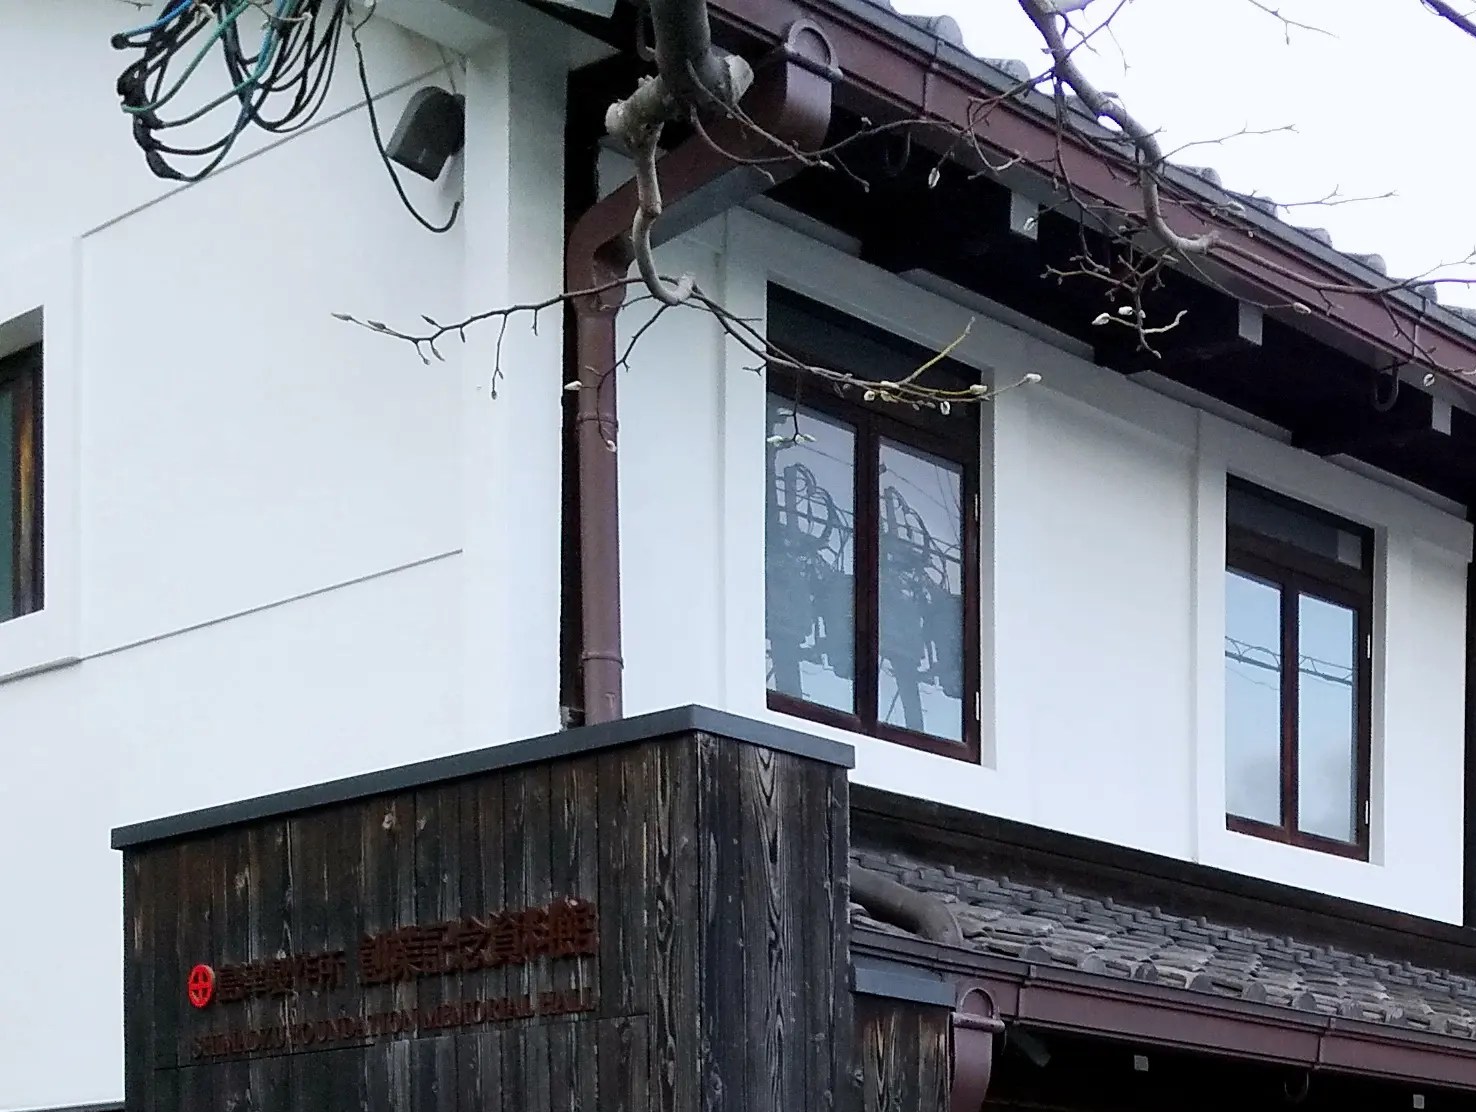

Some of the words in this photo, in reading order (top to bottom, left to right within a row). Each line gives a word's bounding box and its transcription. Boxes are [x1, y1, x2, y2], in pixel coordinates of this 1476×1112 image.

[290, 1009, 418, 1046] FOUNDATION
[424, 995, 534, 1028] MEMORIAL
[538, 988, 597, 1016] HALL
